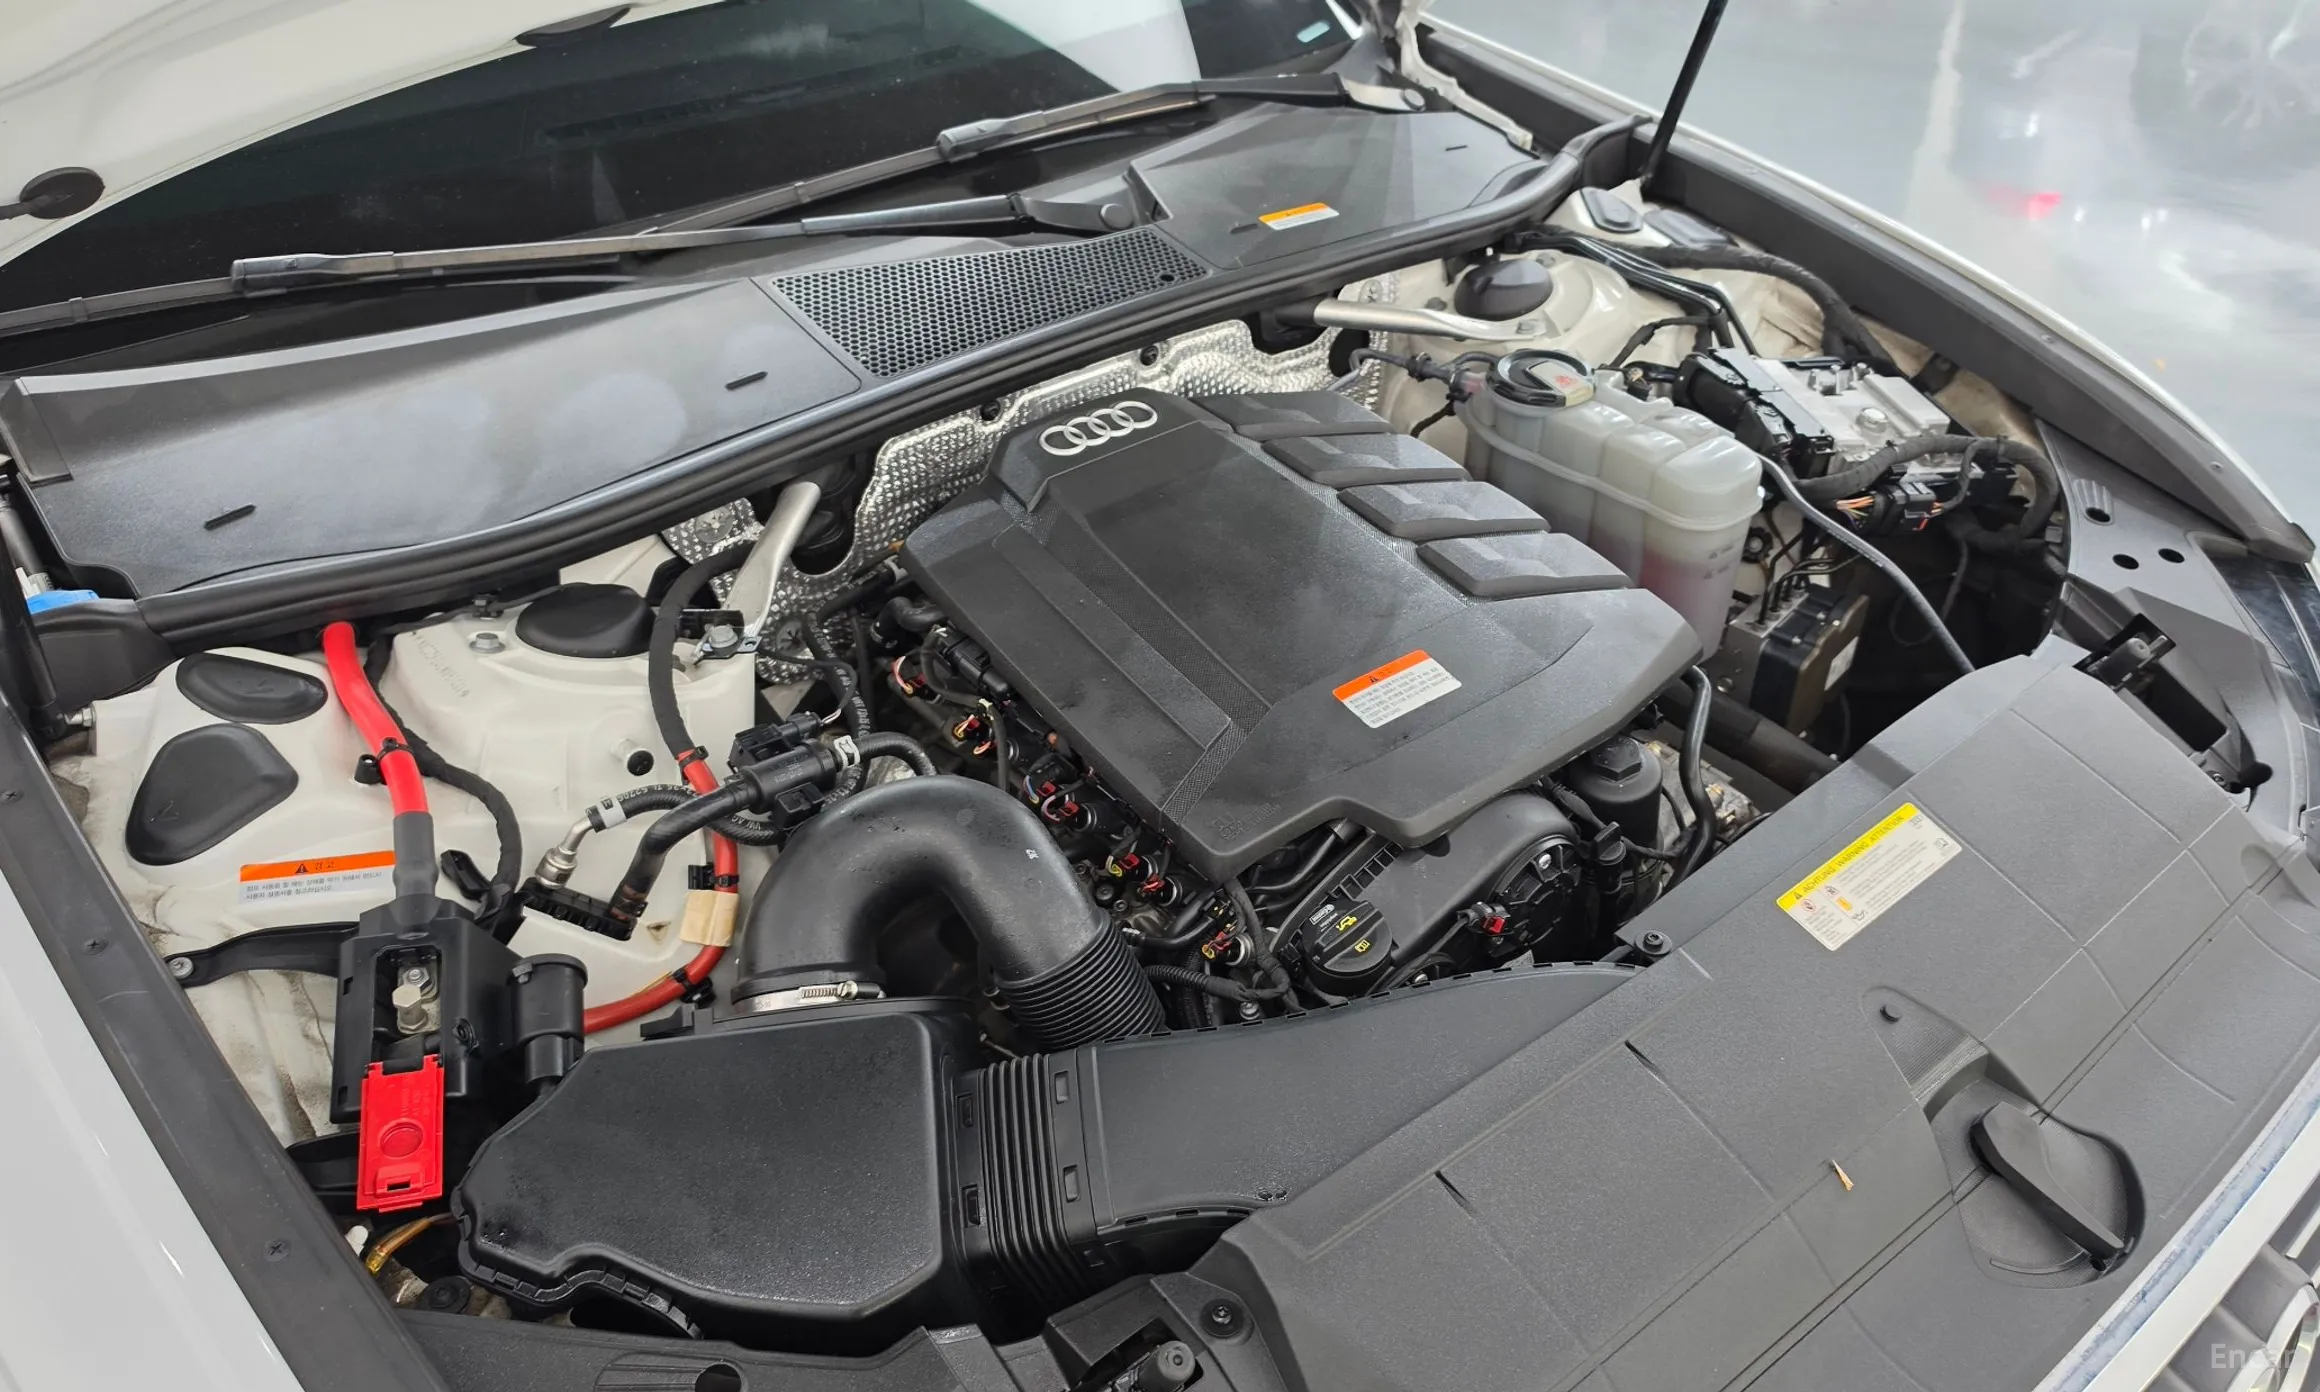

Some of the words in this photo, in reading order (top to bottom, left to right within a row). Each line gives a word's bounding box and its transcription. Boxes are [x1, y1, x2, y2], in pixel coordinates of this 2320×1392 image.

[1803, 866, 1837, 893] ACHTUNG
[1836, 841, 1869, 867] WARNING
[1869, 815, 1905, 842] ATTENTION
